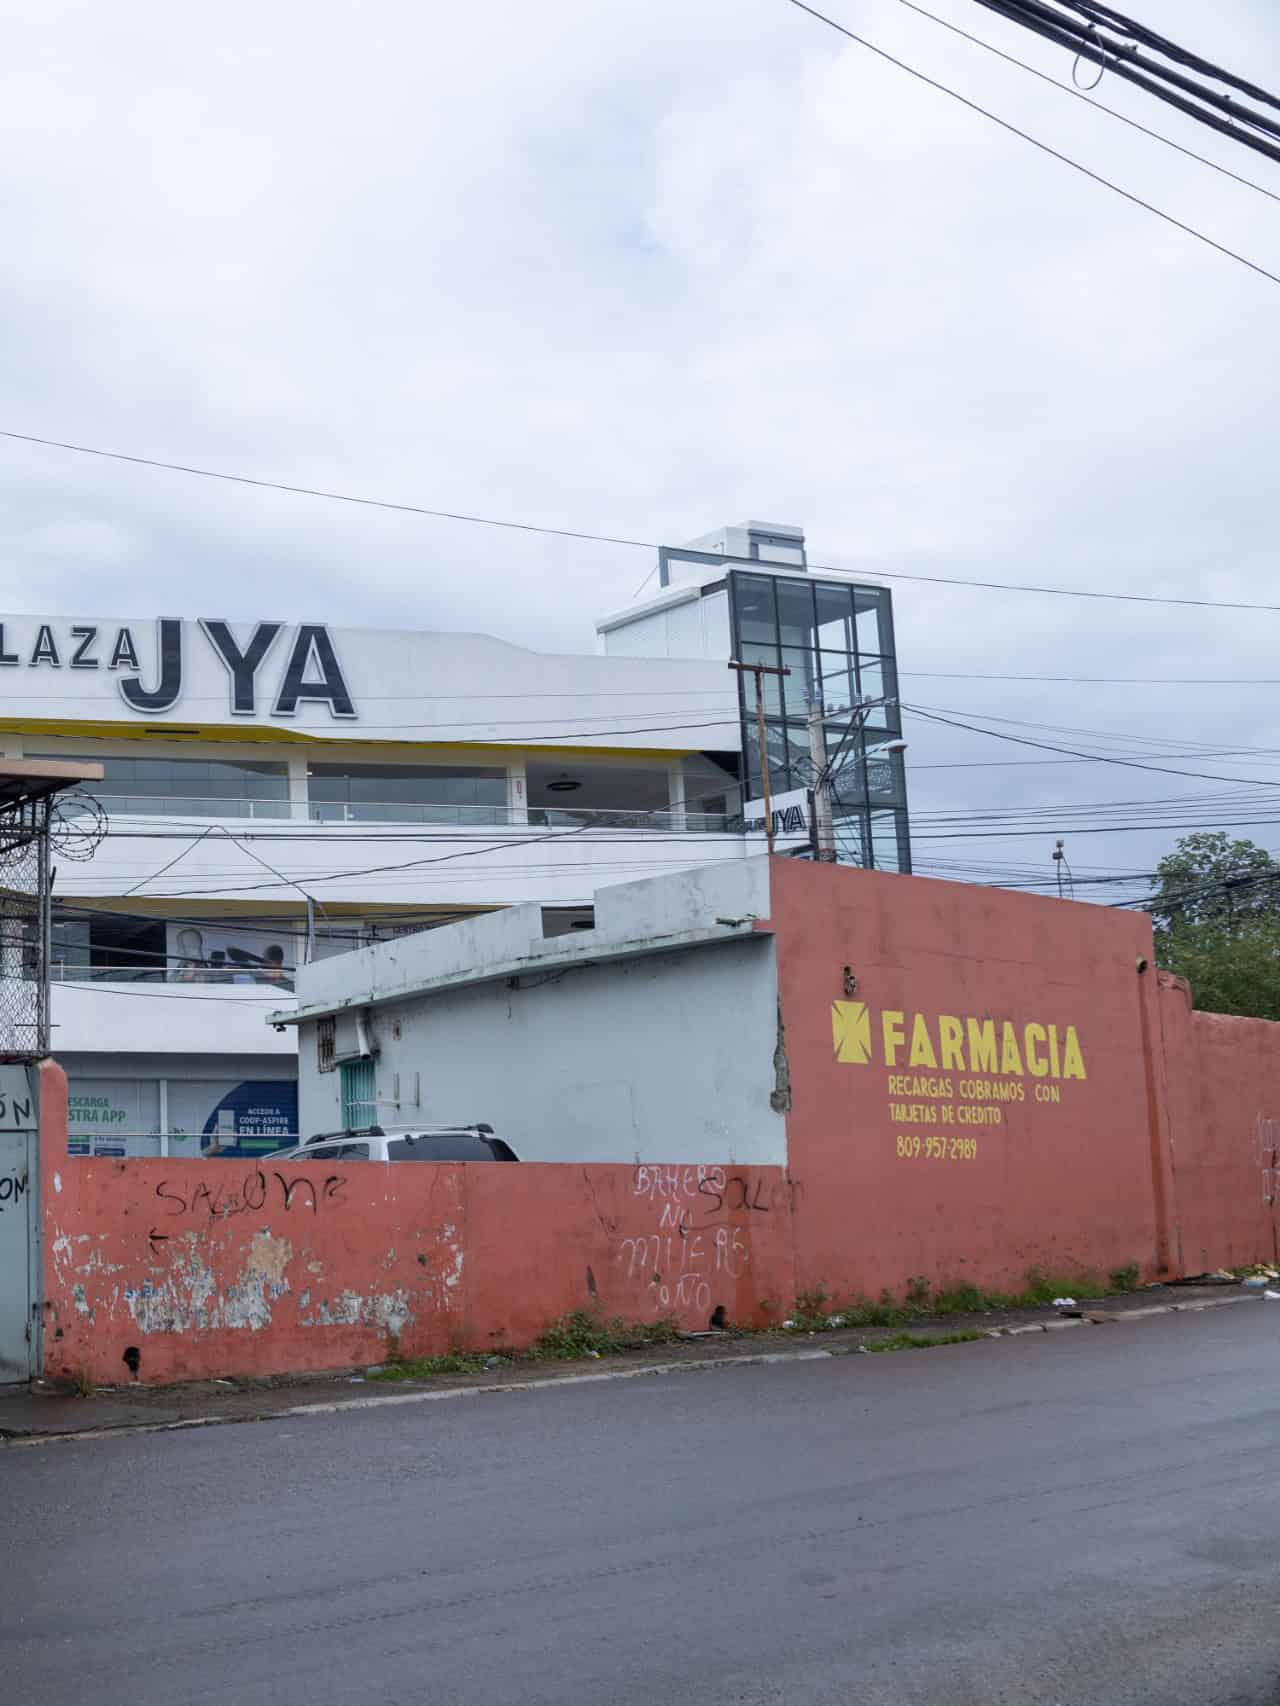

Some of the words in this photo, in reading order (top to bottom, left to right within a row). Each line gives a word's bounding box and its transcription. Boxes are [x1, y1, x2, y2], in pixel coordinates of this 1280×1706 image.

[120, 616, 359, 719] JYA
[881, 1010, 1088, 1081] FARMACIA
[888, 1074, 953, 1099] RECARGAS
[959, 1079, 1025, 1102] COBRAMOS
[1035, 1083, 1061, 1104] CON
[67, 1096, 110, 1108] ESCARGA
[101, 1109, 127, 1123] APP
[941, 1105, 955, 1124] DE
